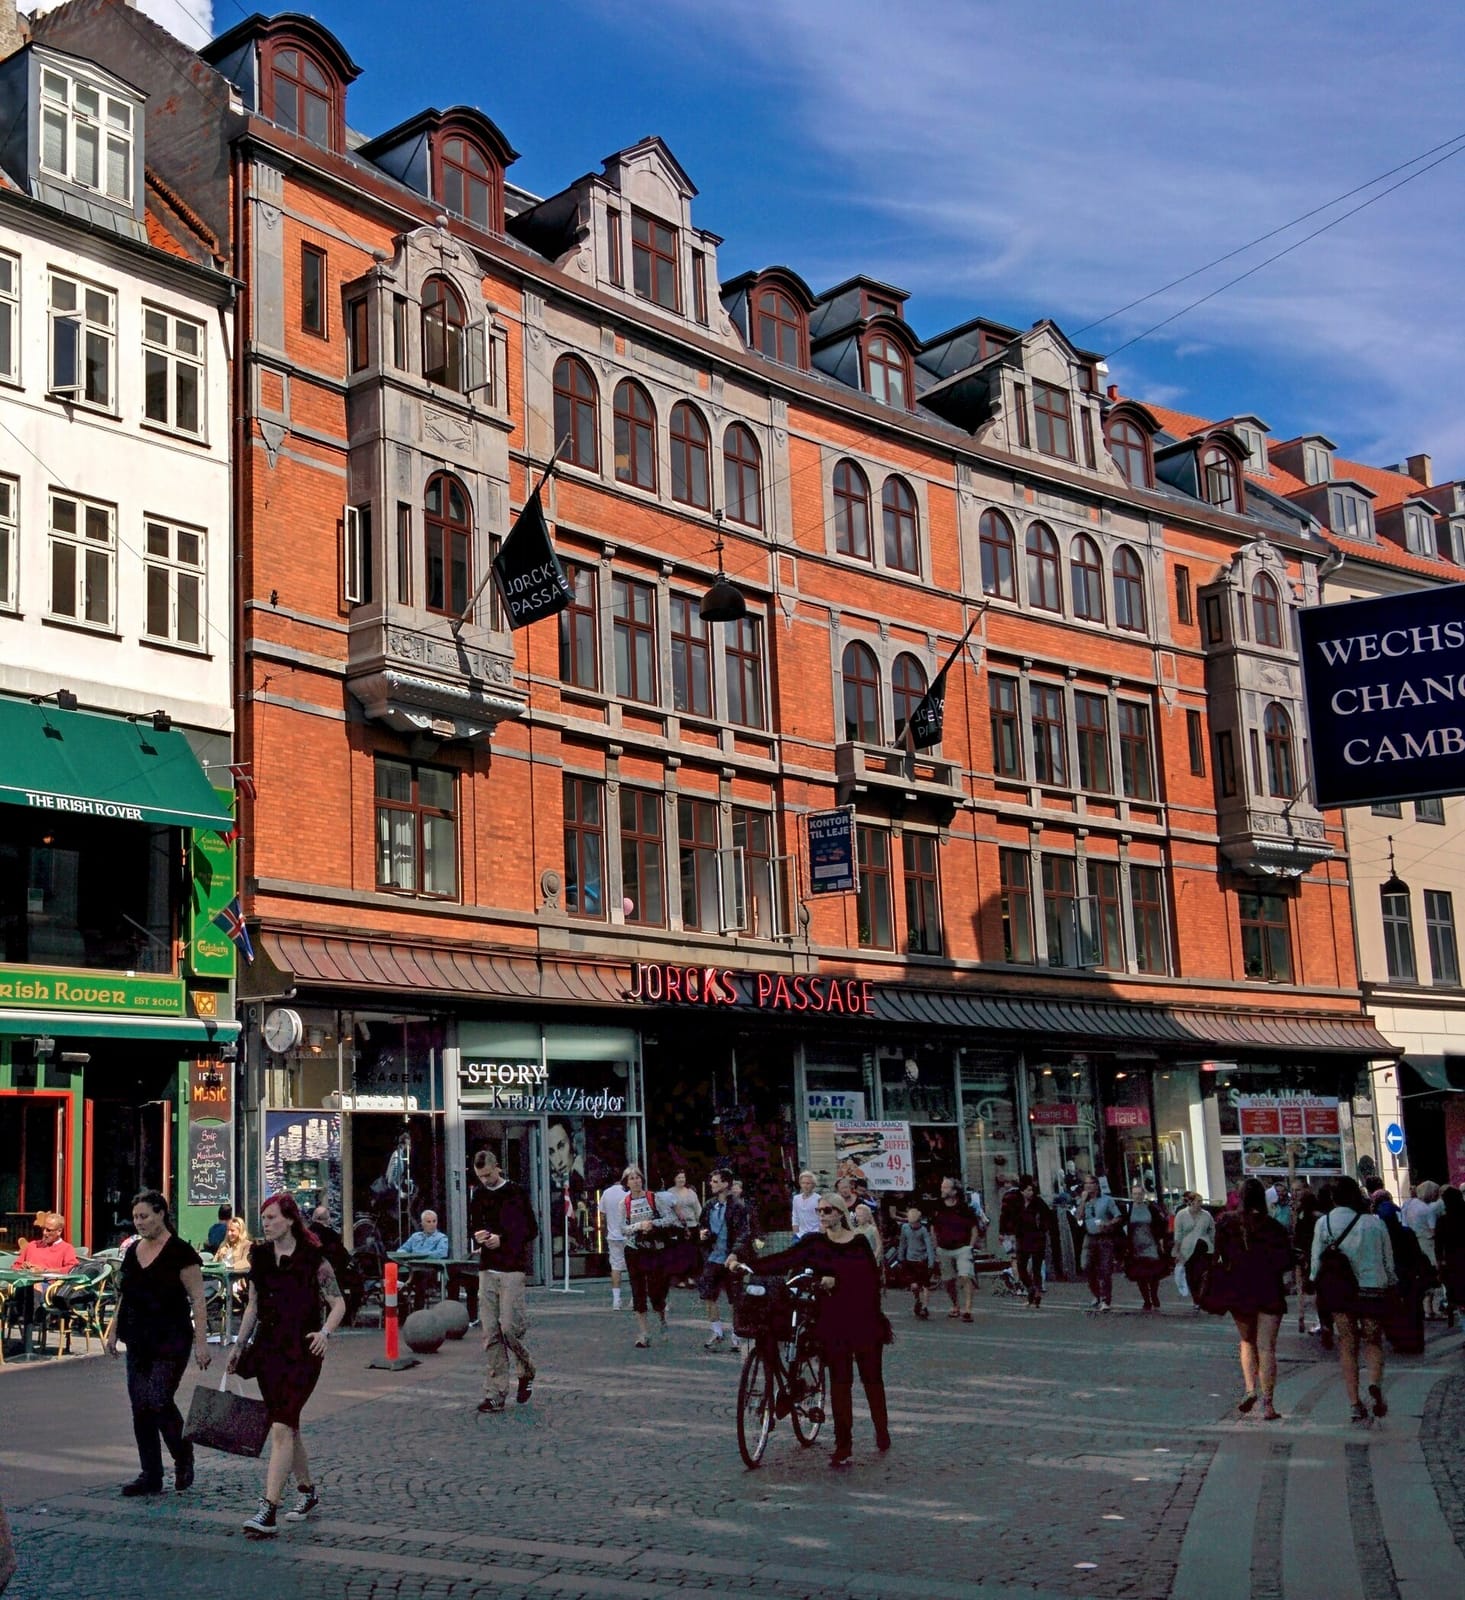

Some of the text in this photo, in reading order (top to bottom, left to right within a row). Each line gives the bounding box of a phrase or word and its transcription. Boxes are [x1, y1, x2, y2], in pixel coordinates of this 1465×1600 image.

[1317, 620, 1465, 667] WECHS
[1343, 727, 1465, 766] CAMB
[26, 793, 144, 821] THE IRISH ROVER
[810, 816, 849, 829] KONTOR
[810, 826, 850, 840] TIL LEJE
[197, 939, 229, 957] Carlsberg
[629, 963, 876, 1014] JORCKS PASSAGE
[134, 997, 149, 1005] EST
[152, 998, 179, 1007] 2004
[352, 1071, 425, 1084] SKAGEN
[468, 1063, 545, 1085] STORY
[194, 1085, 227, 1102] MUSIC
[808, 1095, 846, 1107] SPORT
[1250, 1098, 1325, 1107] NEW ANKARA
[839, 1120, 878, 1128] RESTAURANT
[884, 1140, 909, 1150] BUFFET
